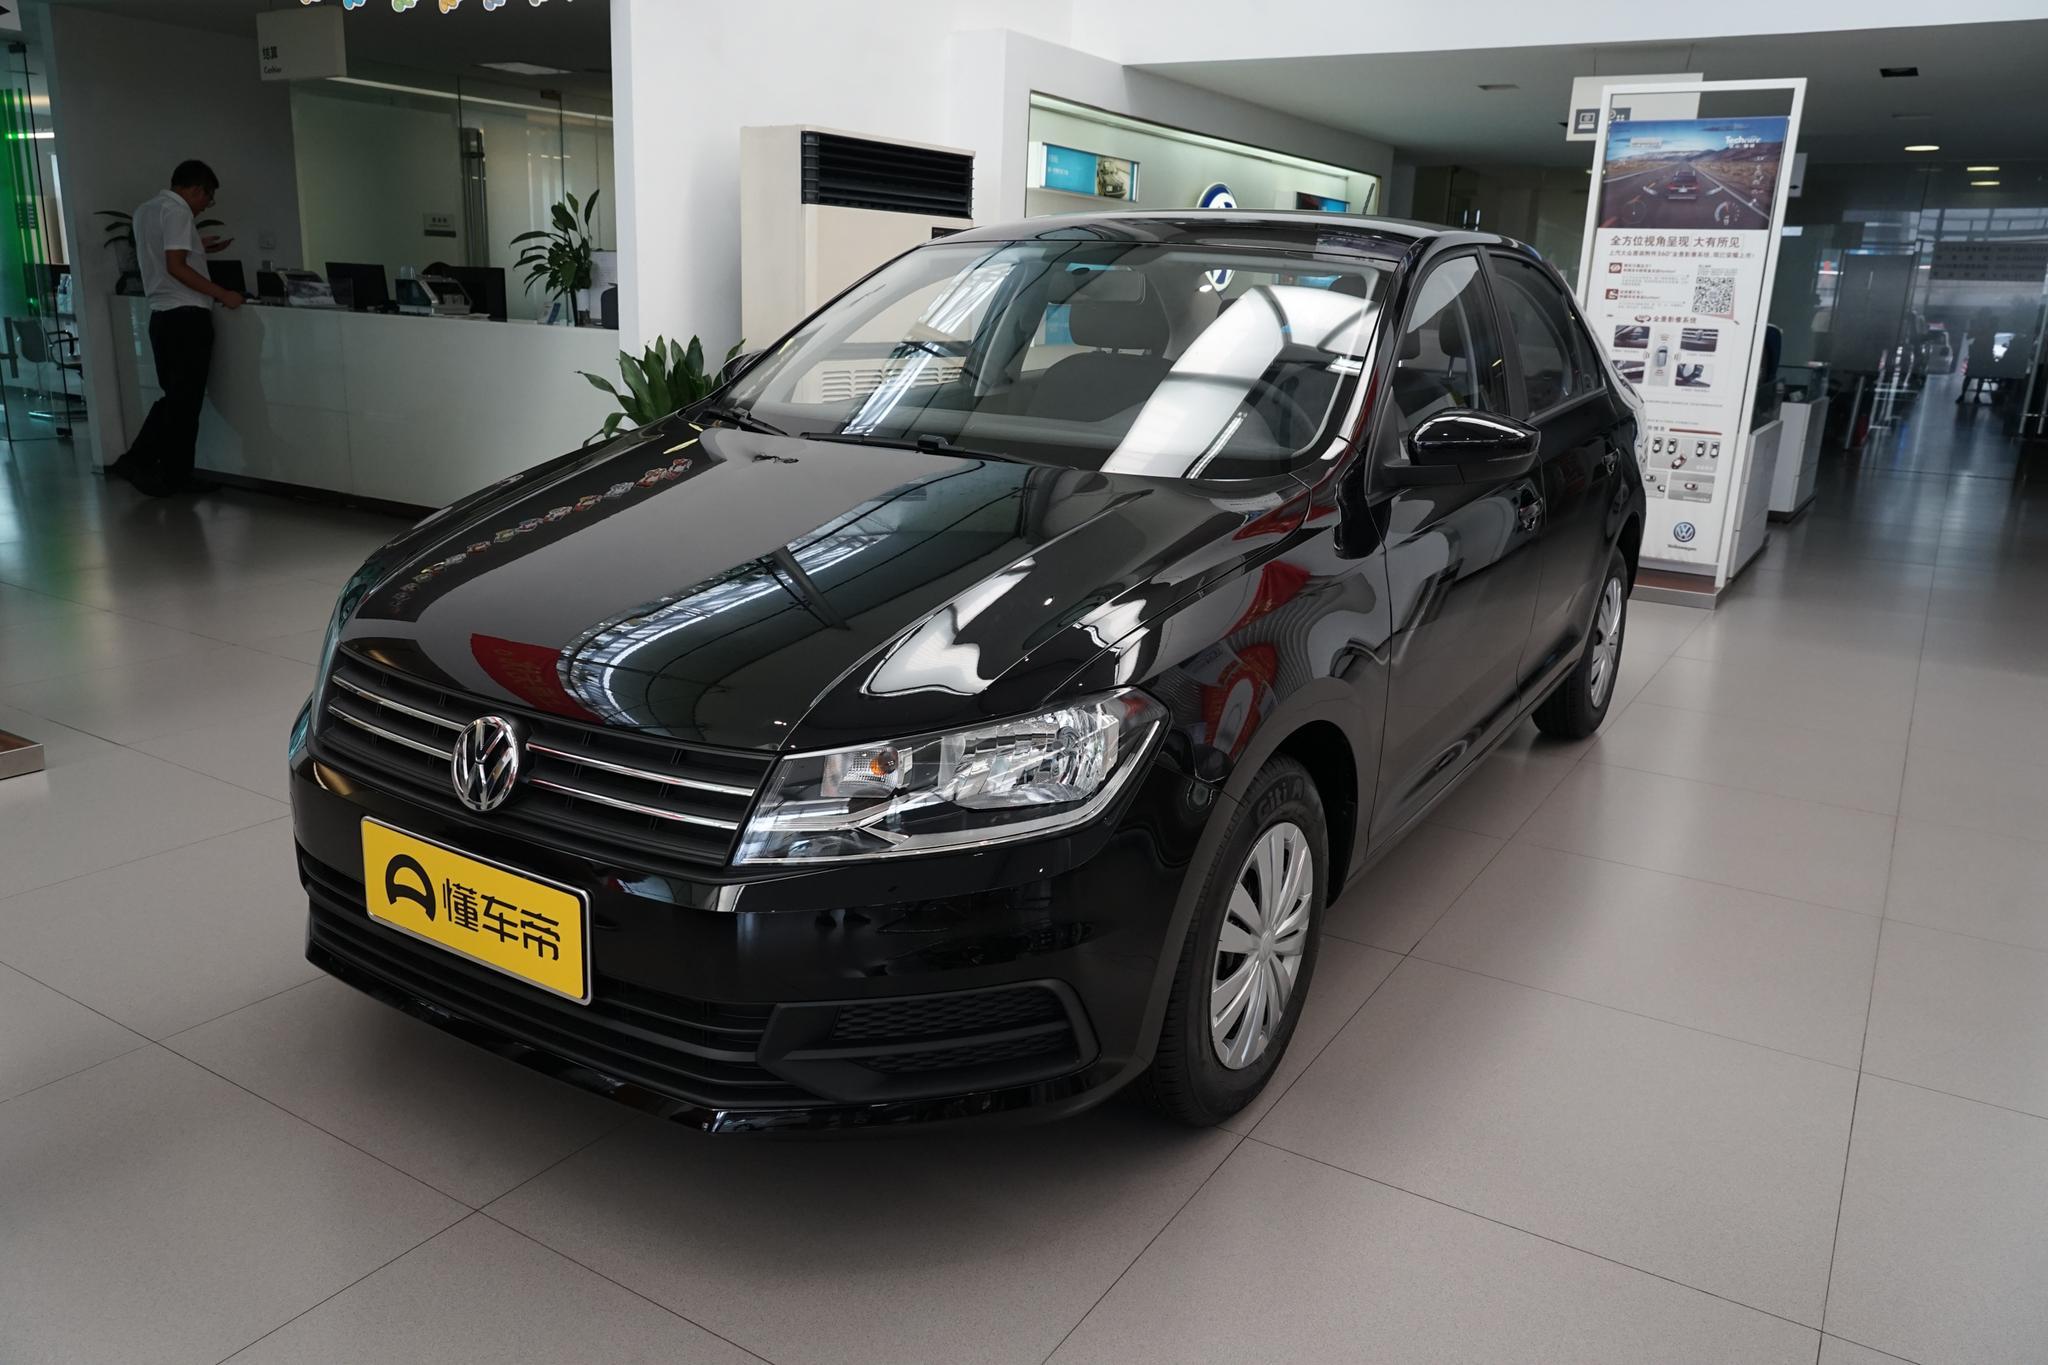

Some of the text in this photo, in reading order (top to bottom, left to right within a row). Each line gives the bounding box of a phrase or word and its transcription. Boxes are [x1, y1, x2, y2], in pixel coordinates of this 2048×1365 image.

[1610, 235, 1740, 248] 全方位视角呈现 大有所见
[442, 878, 561, 961] 懂车帝
